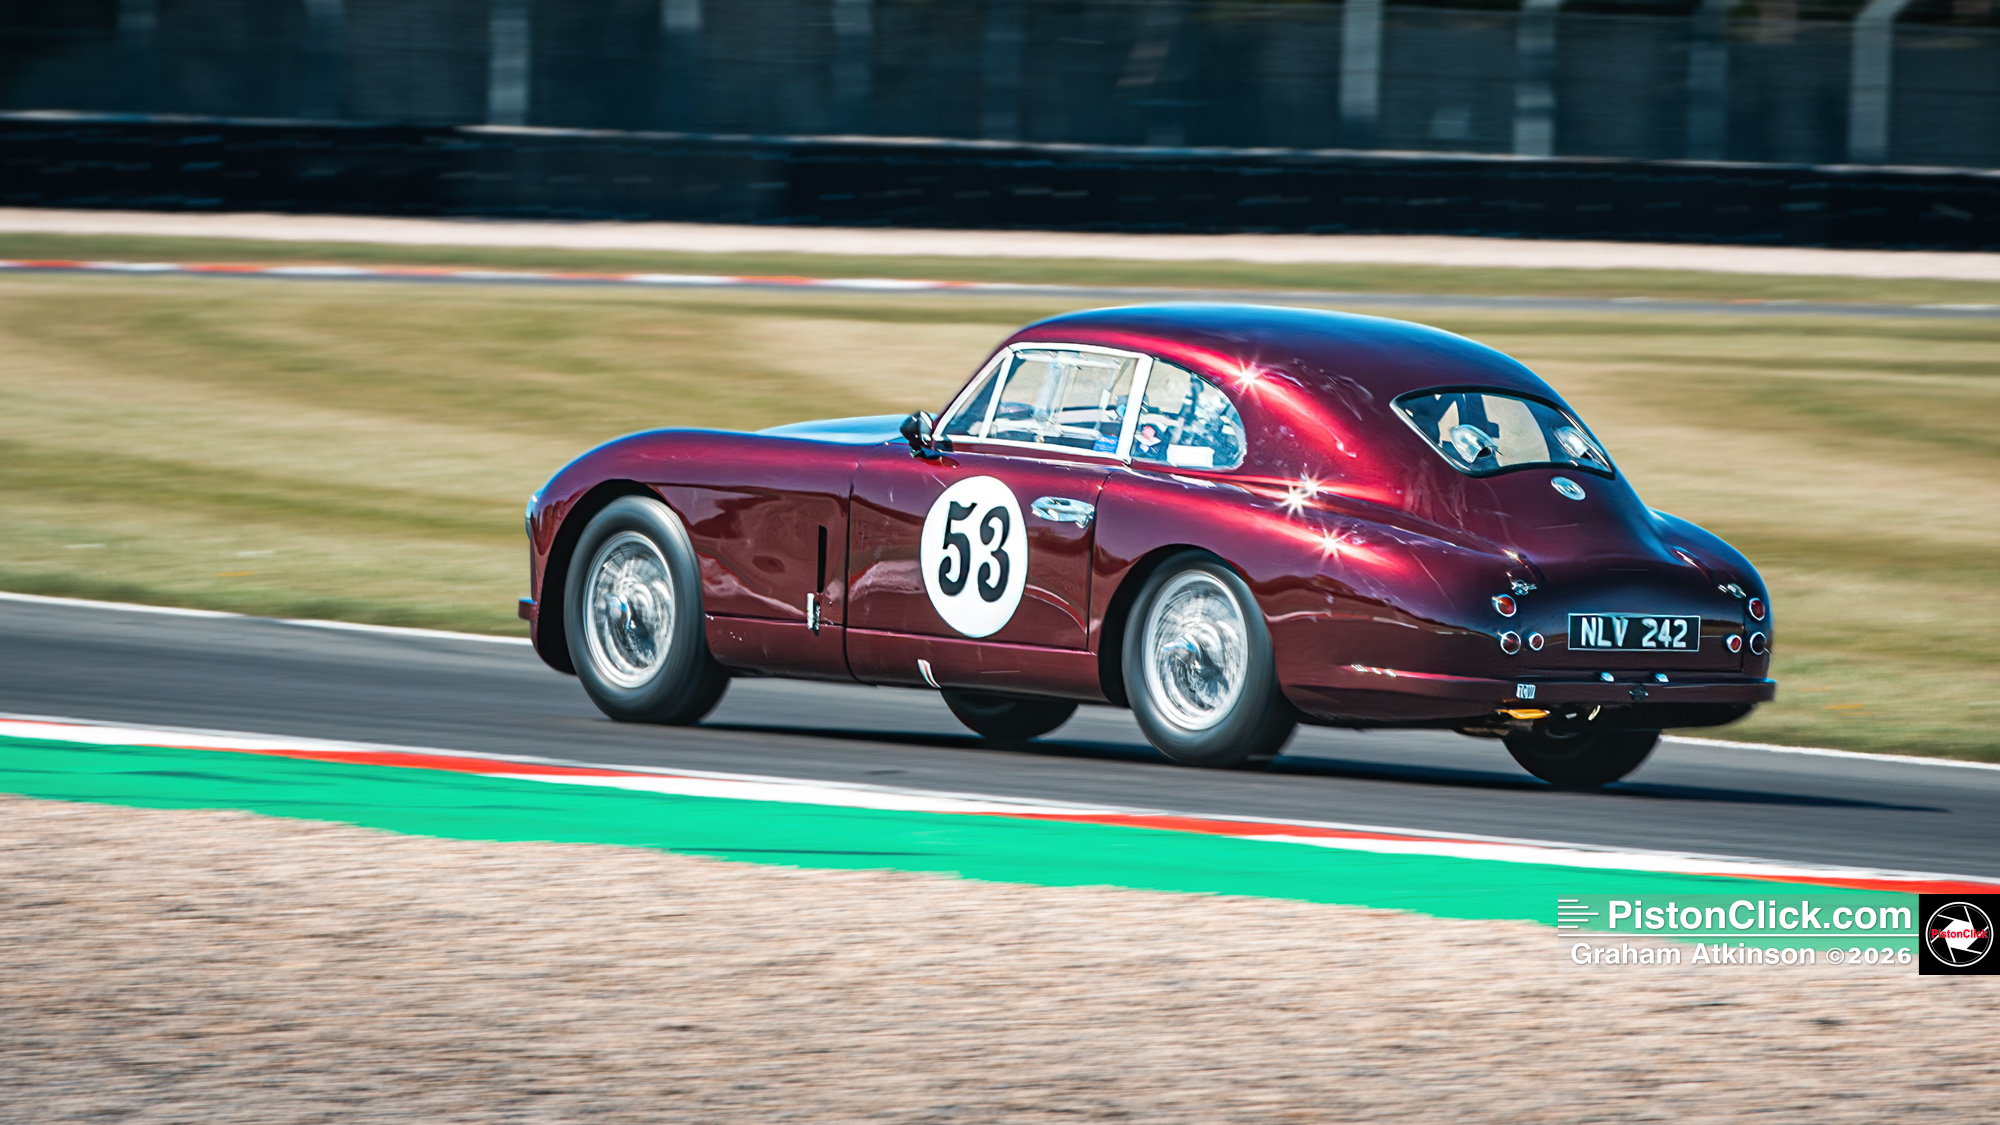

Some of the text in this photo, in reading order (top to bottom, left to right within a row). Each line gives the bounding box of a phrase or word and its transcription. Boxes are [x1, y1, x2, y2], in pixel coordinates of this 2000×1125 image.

[938, 501, 1010, 603] 53
[1581, 616, 1688, 648] NLV 242
